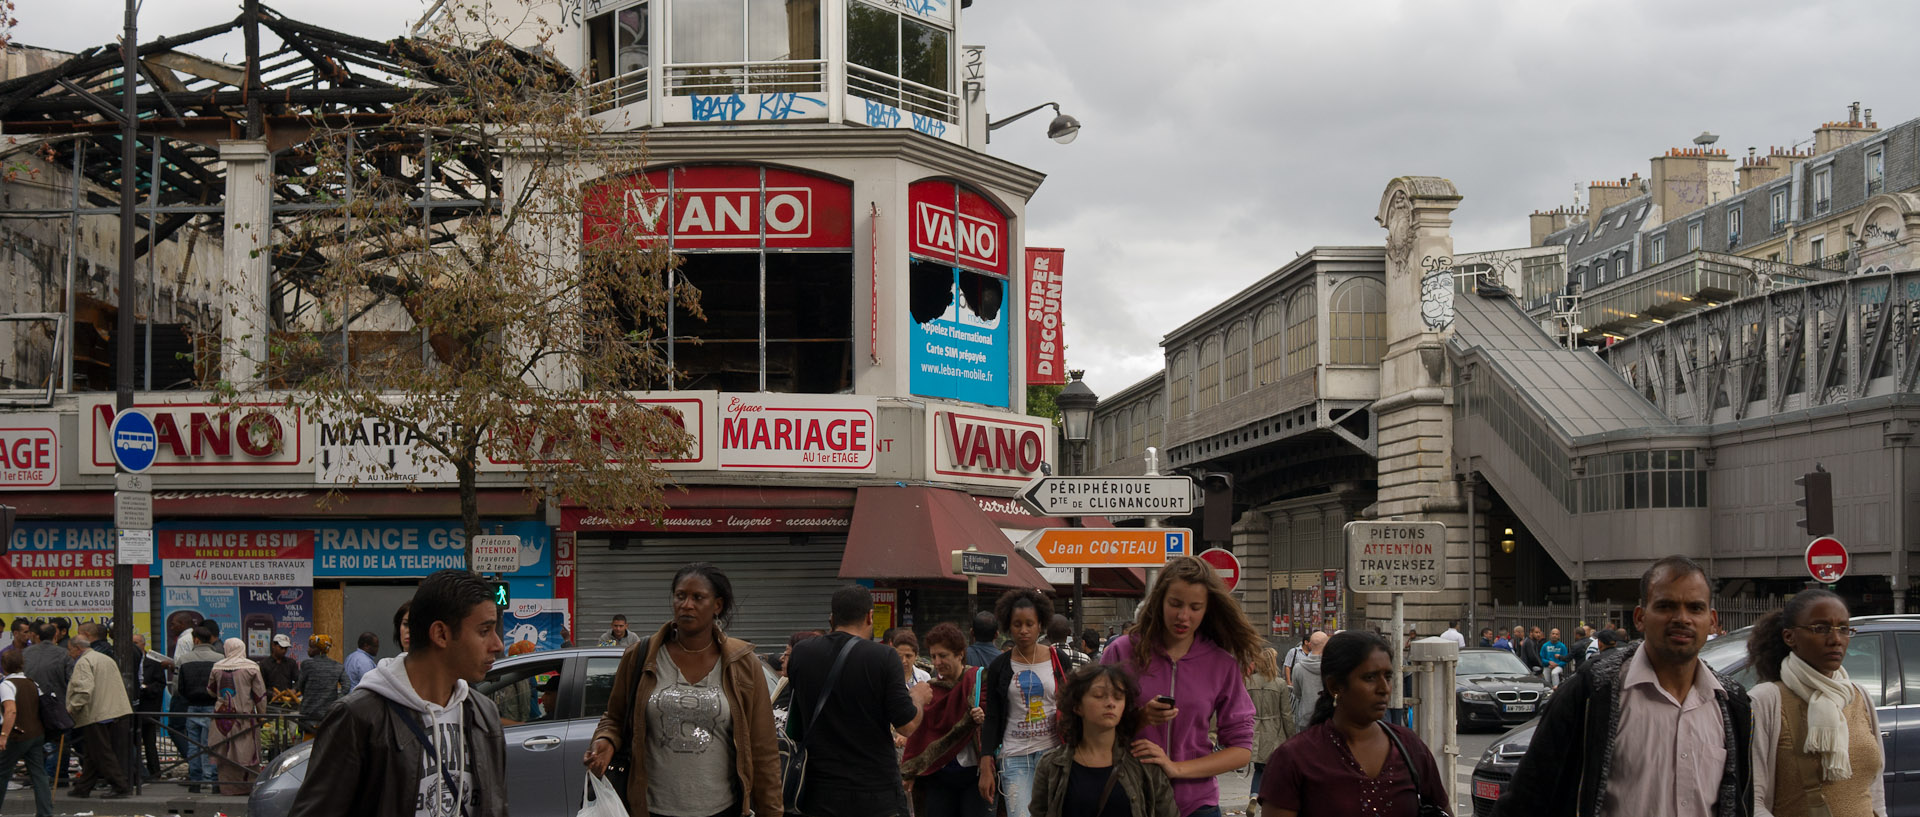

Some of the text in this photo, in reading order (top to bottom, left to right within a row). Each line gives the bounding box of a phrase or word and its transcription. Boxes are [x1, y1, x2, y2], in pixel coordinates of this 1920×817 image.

[632, 190, 805, 232] VANO
[919, 202, 995, 259] VANO
[1029, 257, 1050, 322] SUPER
[1038, 272, 1063, 375] DISCOUNT
[926, 342, 986, 364] Carte SIM prépayée
[728, 397, 763, 423] Espace
[722, 418, 866, 451] MARIAGE
[946, 411, 1042, 473] VANO
[803, 452, 859, 463] AU 1er ETAGE
[3, 470, 43, 480] 1er ETAGE
[1051, 481, 1151, 494] PÉRIPHÉRIQUE
[1089, 497, 1185, 508] CLIGNANCOURT
[727, 516, 772, 529] lingerie
[785, 517, 849, 527] accessoires
[33, 528, 59, 549] OF
[1370, 526, 1425, 539] PIÉTONS
[175, 533, 298, 547] FRANCE GSM
[1170, 536, 1179, 549] P
[195, 549, 277, 557] KING OF BARBES
[1049, 540, 1083, 554] Jean
[1364, 544, 1432, 554] ATTENTION
[11, 553, 84, 568] FRANCE
[170, 560, 207, 568] DÉPLACÉ
[322, 555, 337, 568] LE
[340, 555, 359, 568] ROI
[363, 555, 378, 568] DE
[381, 555, 396, 568] LA
[1361, 560, 1435, 570] TRAVERSEZ
[32, 569, 112, 577] KING OF BARBES
[193, 569, 208, 580] 40
[494, 564, 516, 572] temps
[6, 579, 43, 588] DÉPLACÉ
[46, 580, 82, 588] PENDANT
[1359, 575, 1436, 585] EN 2 TEMPS
[43, 587, 58, 598] 24
[61, 590, 110, 598] BOULEVARD
[169, 589, 193, 600] Pack
[249, 589, 273, 601] Pack
